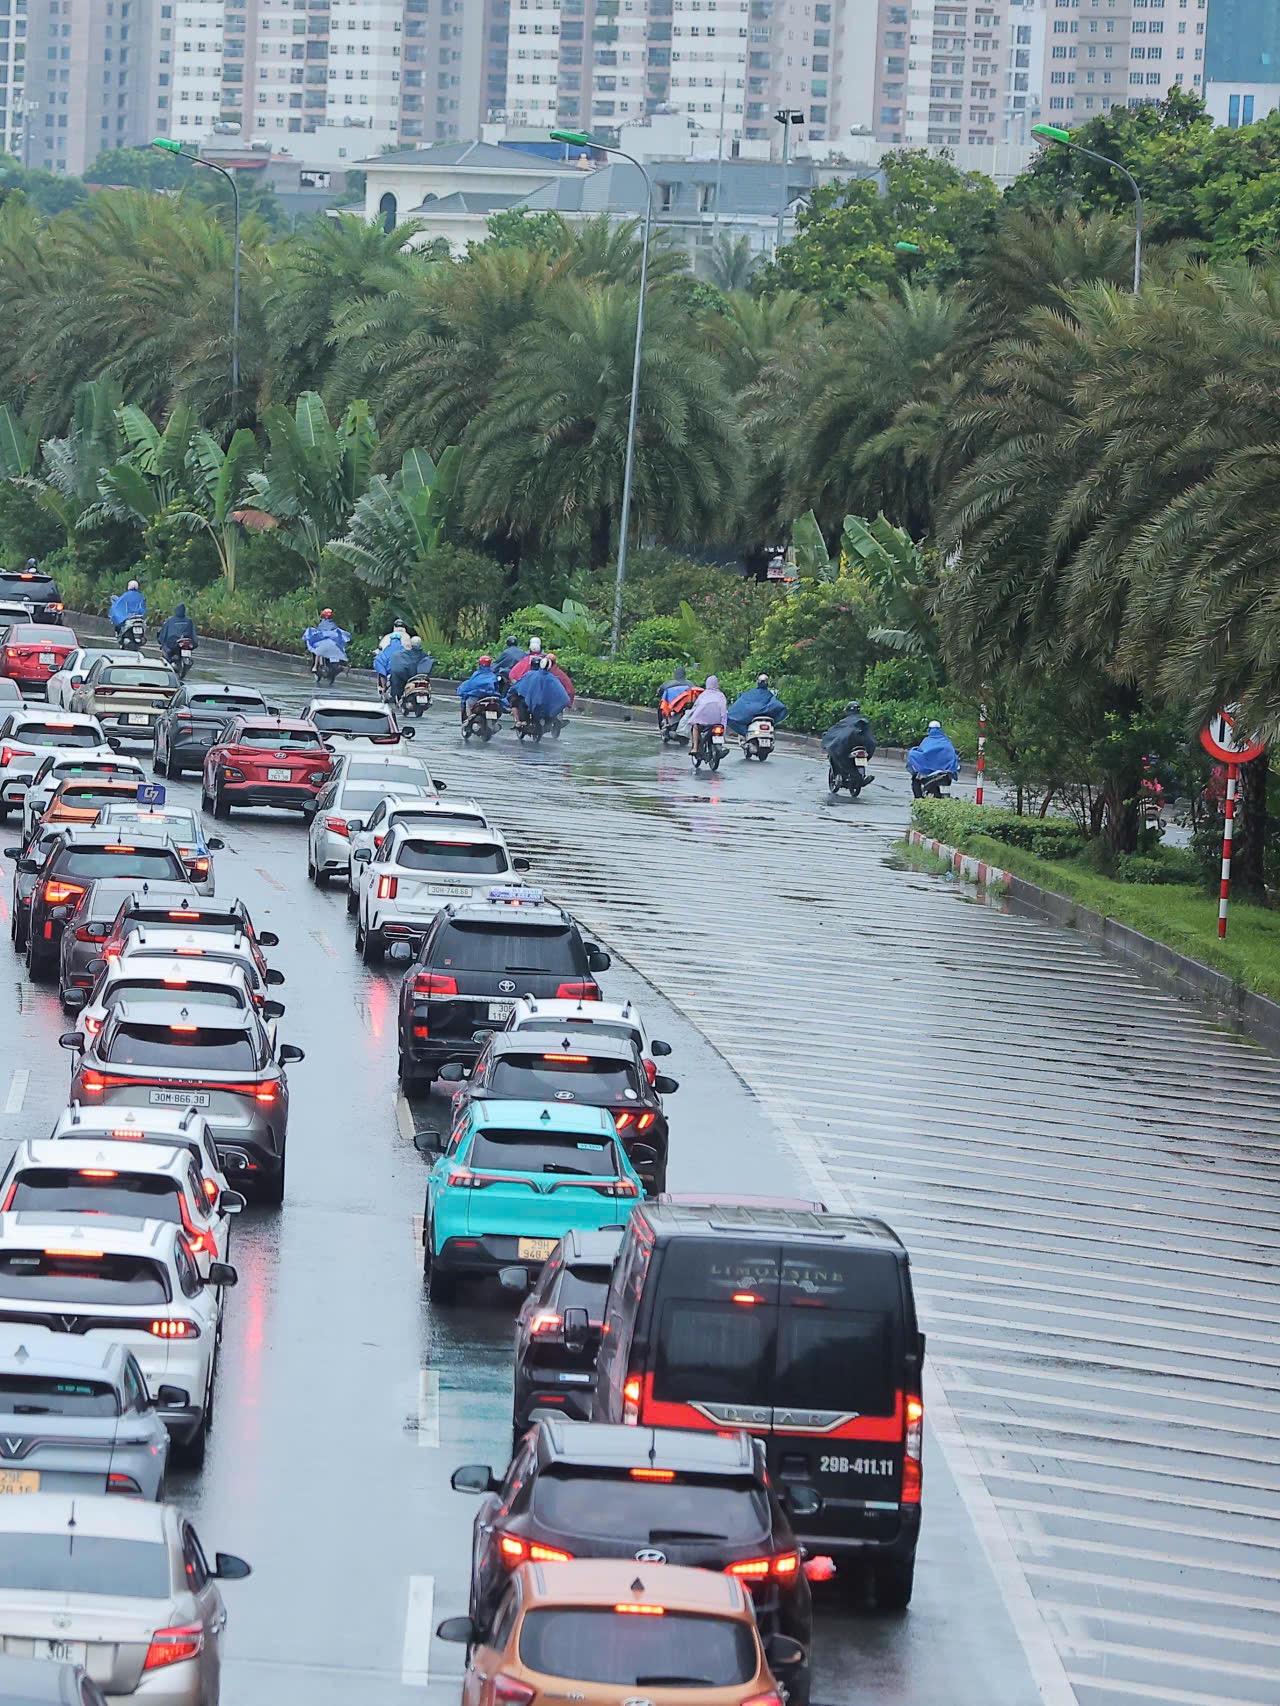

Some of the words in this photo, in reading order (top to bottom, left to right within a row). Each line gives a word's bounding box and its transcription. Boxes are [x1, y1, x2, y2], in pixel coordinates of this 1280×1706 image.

[144, 787, 159, 801] G7
[523, 1249, 550, 1260] 948.3
[711, 1264, 843, 1281] LIMOUSINE
[820, 1456, 893, 1476] 29B-411.11
